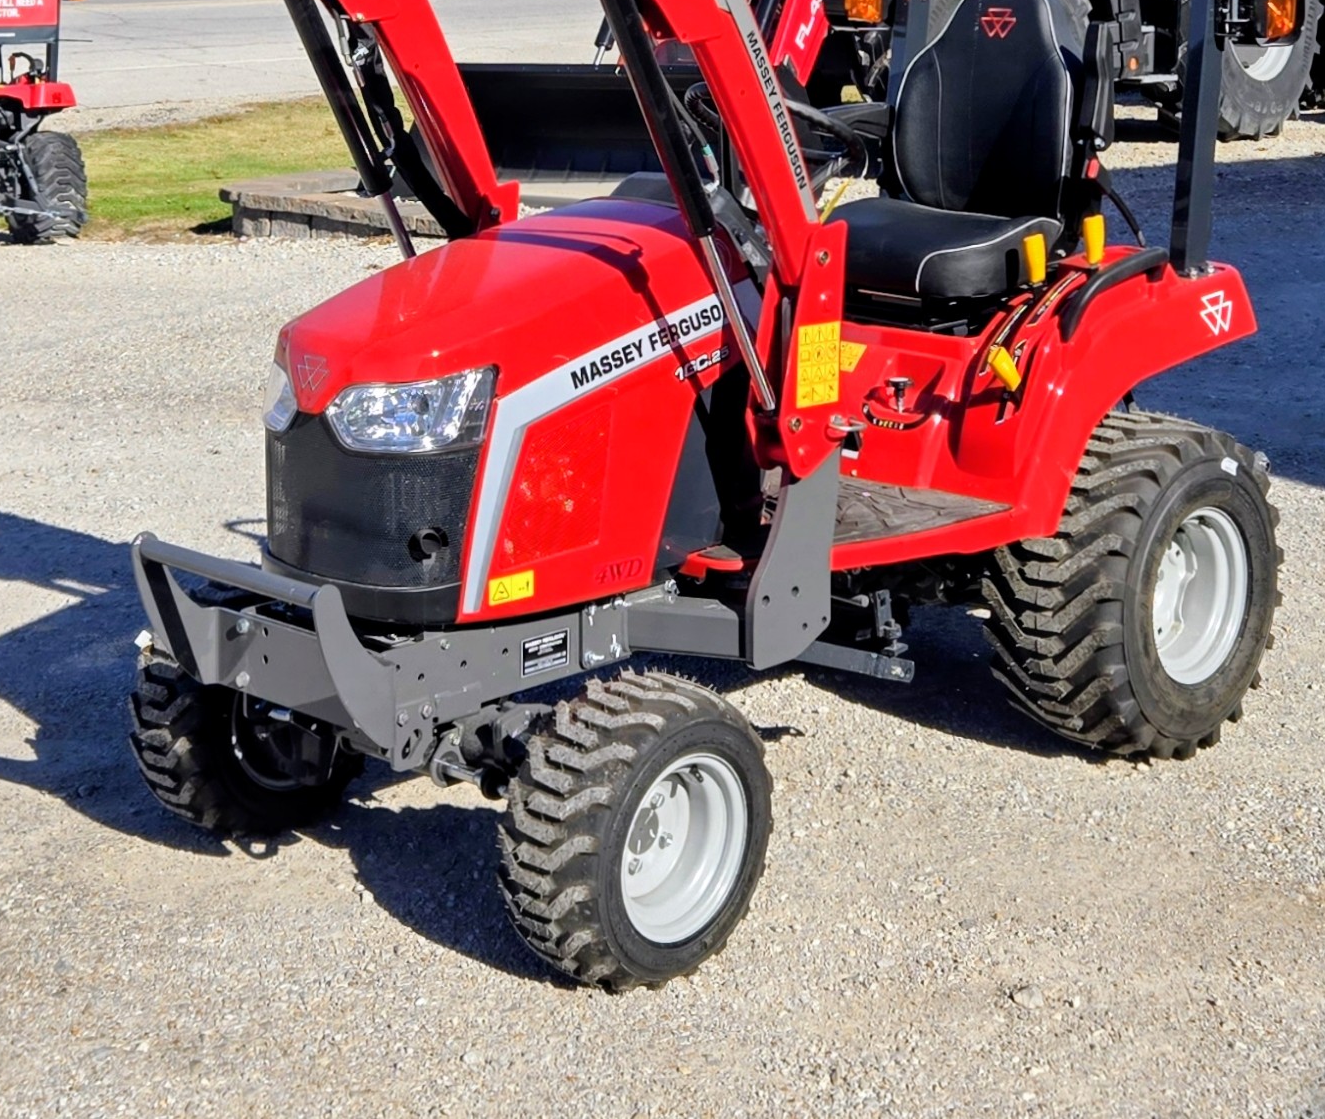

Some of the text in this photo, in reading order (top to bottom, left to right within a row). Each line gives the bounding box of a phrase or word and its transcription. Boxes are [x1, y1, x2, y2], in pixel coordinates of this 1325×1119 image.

[746, 31, 807, 190] MASSEY FERGUSON
[570, 304, 725, 389] MASSEY FERGUSO
[596, 557, 644, 585] 4WD
